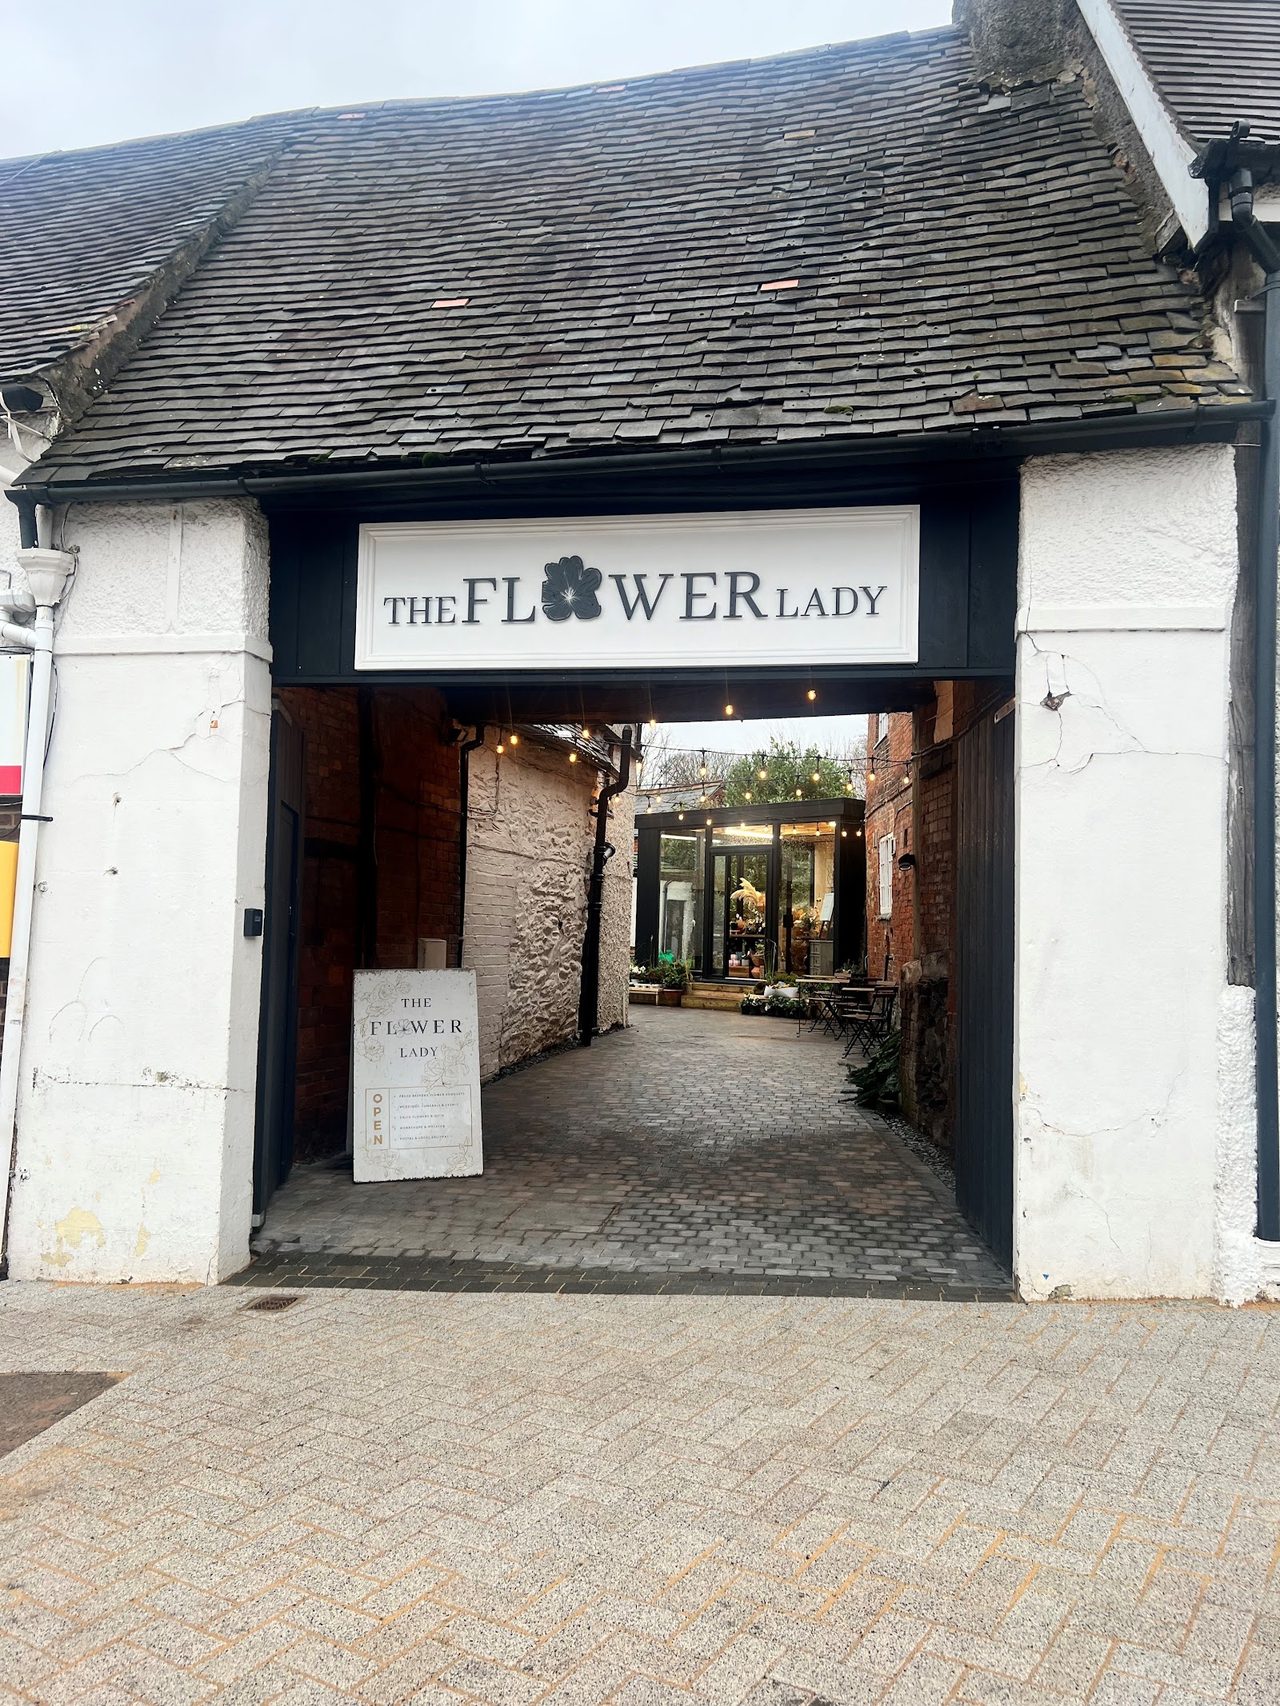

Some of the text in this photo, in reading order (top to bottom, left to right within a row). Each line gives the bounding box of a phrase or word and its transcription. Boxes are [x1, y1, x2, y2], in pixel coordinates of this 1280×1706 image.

[384, 596, 456, 625] THE
[776, 585, 888, 618] LADY
[401, 998, 432, 1008] THE
[400, 1047, 438, 1058] LADY
[373, 1093, 383, 1145] OPEN
